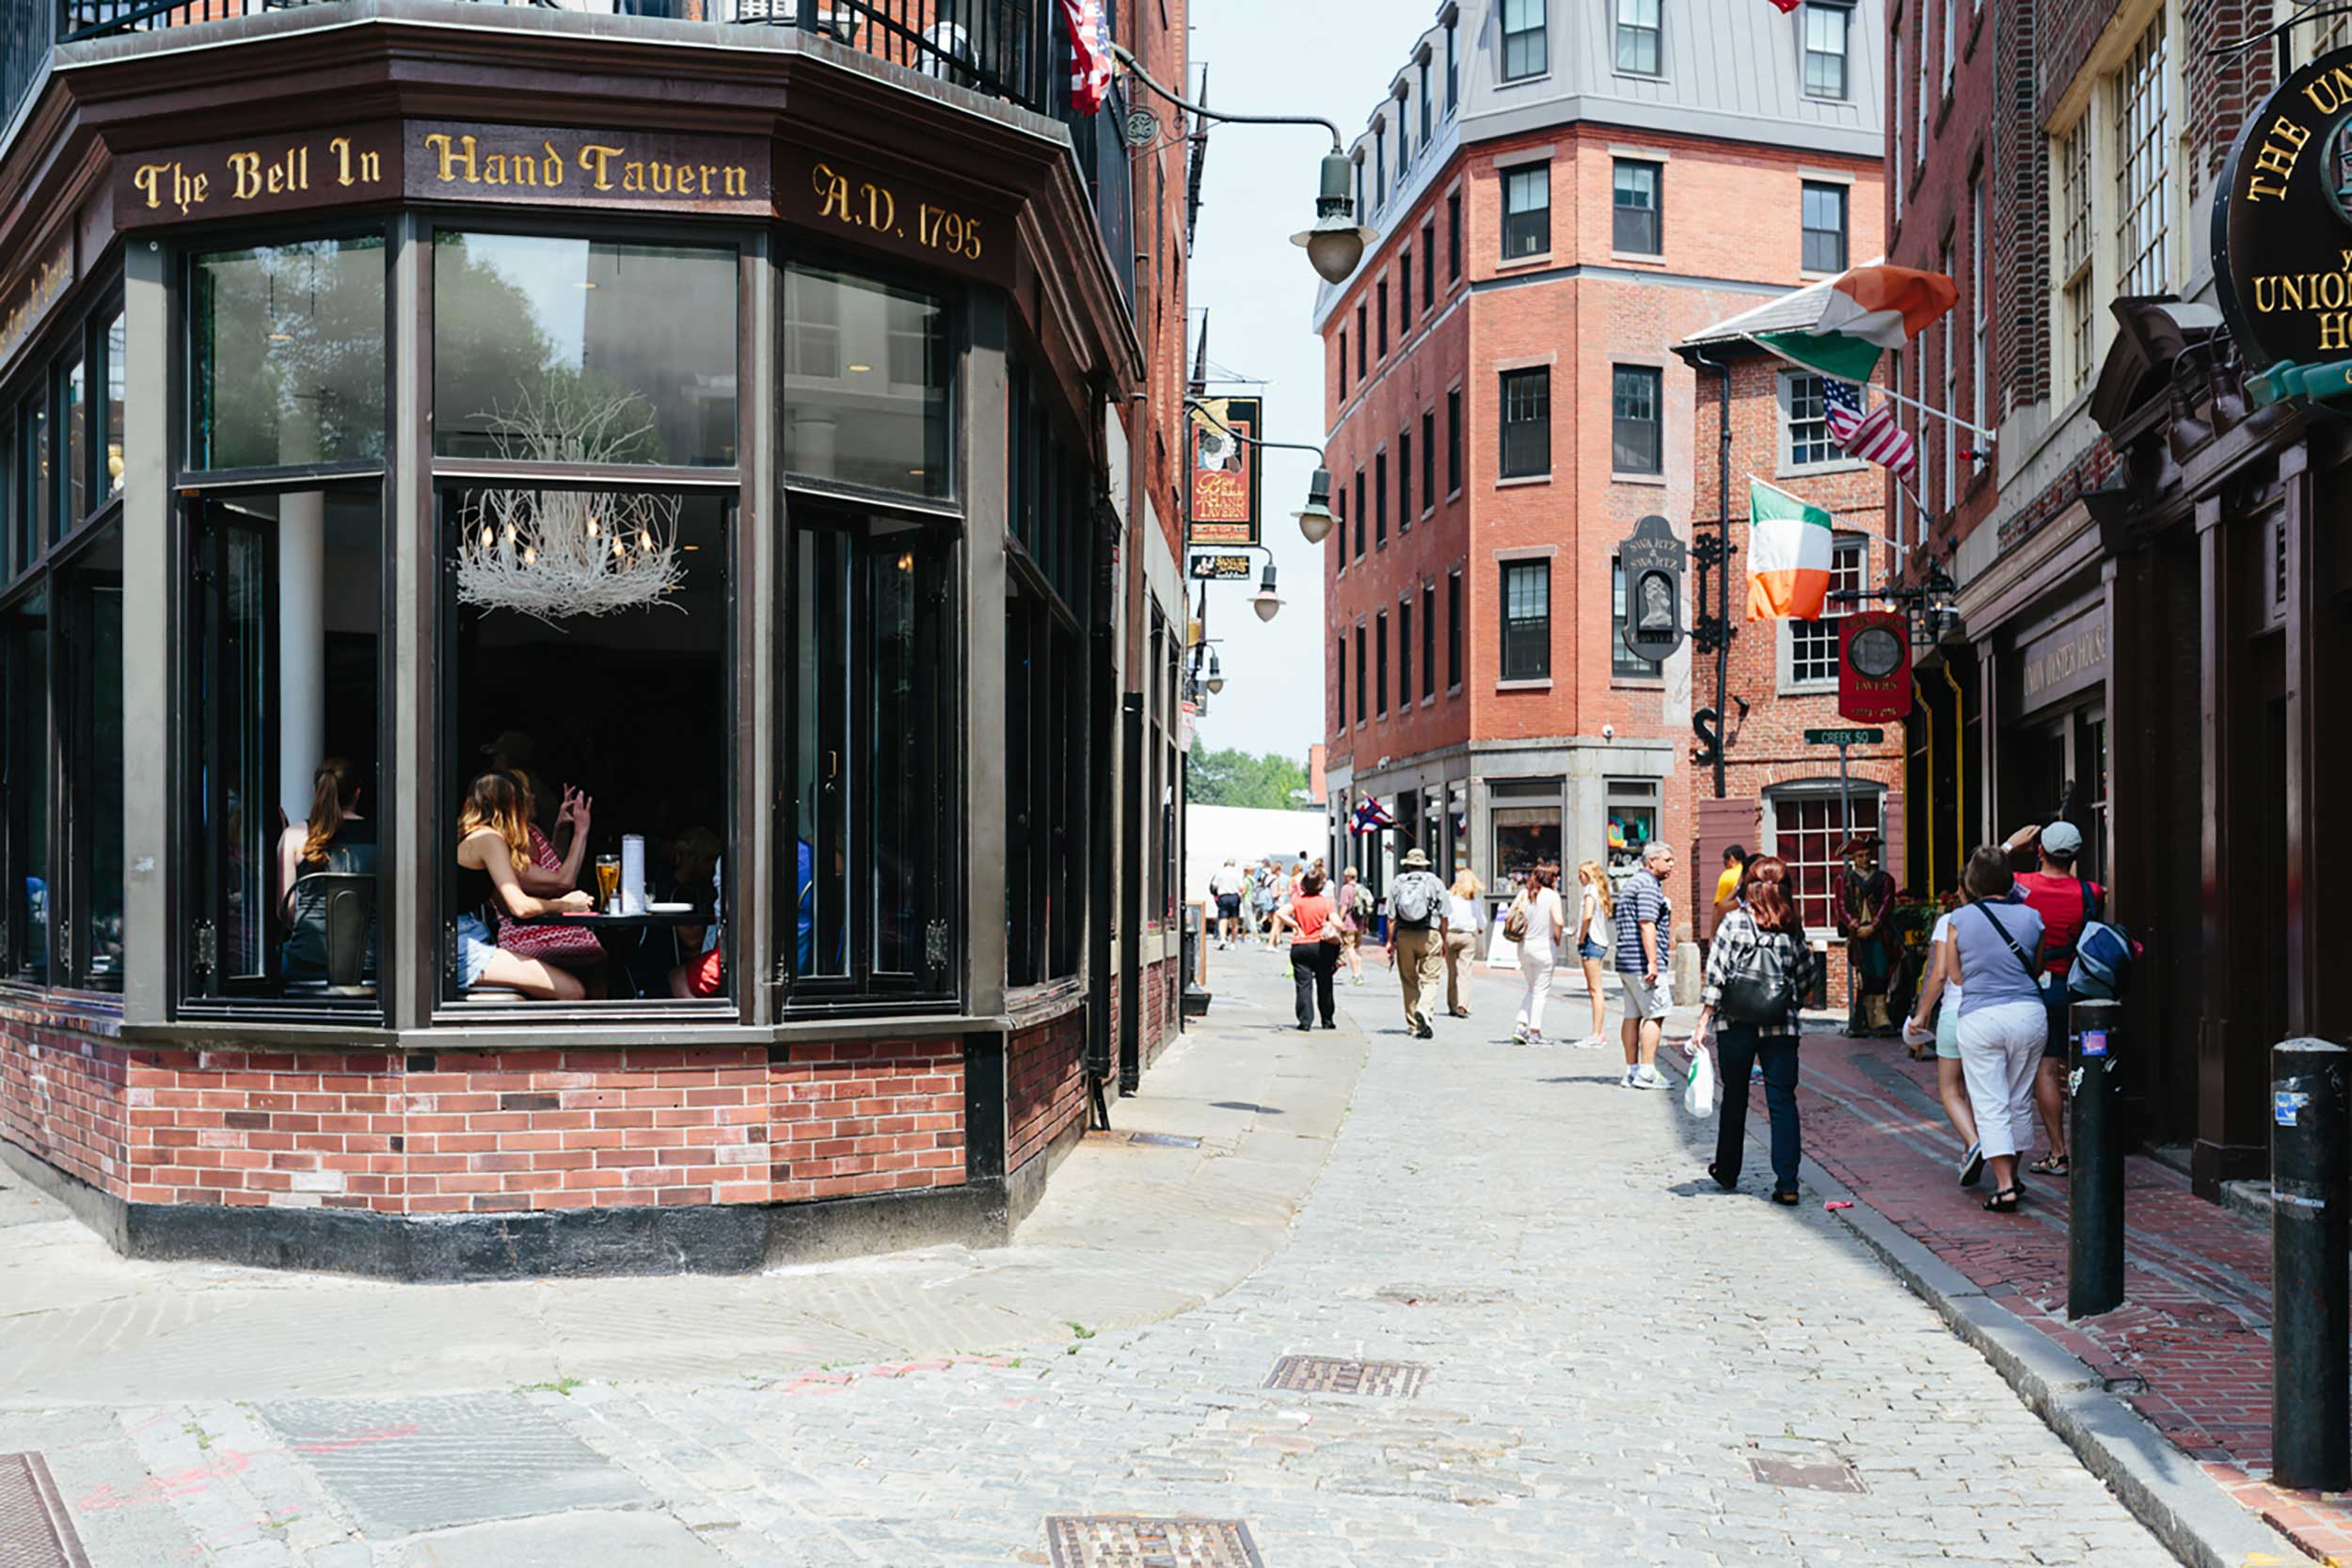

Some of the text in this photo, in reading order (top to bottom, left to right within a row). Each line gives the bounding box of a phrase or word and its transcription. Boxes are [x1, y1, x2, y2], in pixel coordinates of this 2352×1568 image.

[134, 136, 381, 216] The Bell In
[425, 134, 749, 197] Hand Tavern
[2247, 115, 2312, 201] THE
[812, 163, 981, 260] A.D. 1795
[2315, 311, 2352, 350] H
[1629, 538, 1678, 553] SWARTZ
[1629, 556, 1678, 571] SWARTZ
[1853, 679, 1898, 691] TAVERN
[1820, 731, 1869, 744] CREEK SQ
